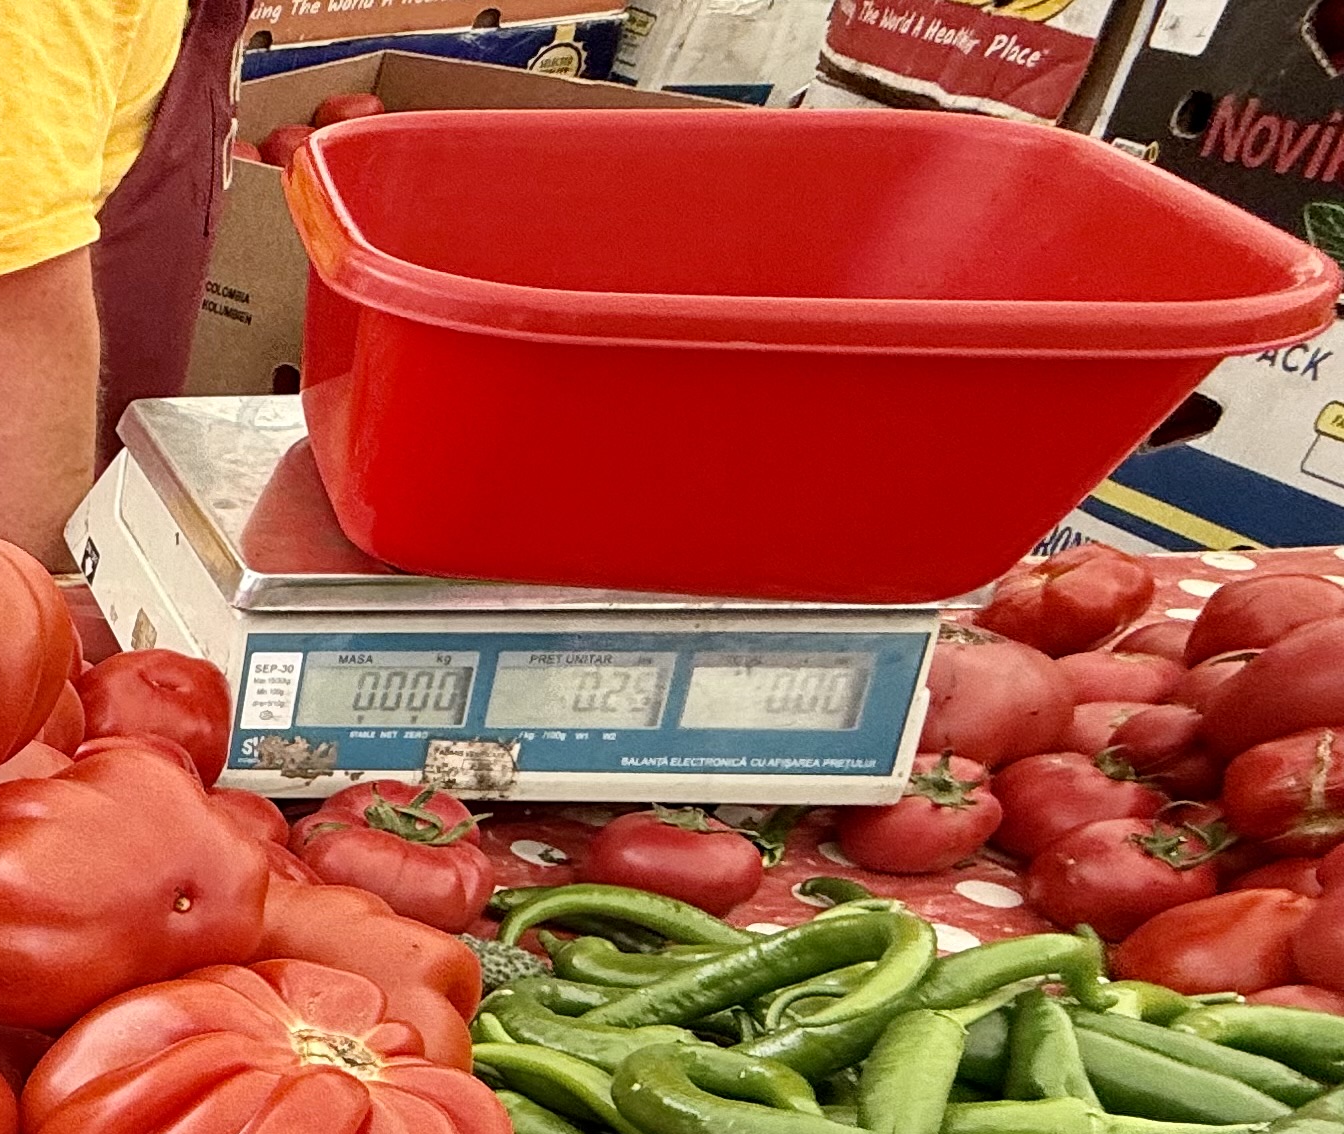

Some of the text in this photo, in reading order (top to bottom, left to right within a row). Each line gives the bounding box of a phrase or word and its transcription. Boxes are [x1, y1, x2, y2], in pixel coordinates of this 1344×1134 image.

[859, 3, 880, 25] The
[879, 9, 914, 34] World
[984, 34, 1042, 68] Place
[338, 654, 452, 666] MASA kg
[254, 664, 294, 674] SEP-30
[350, 731, 428, 739] STABLE NET ZERO
[750, 757, 766, 768] CU
